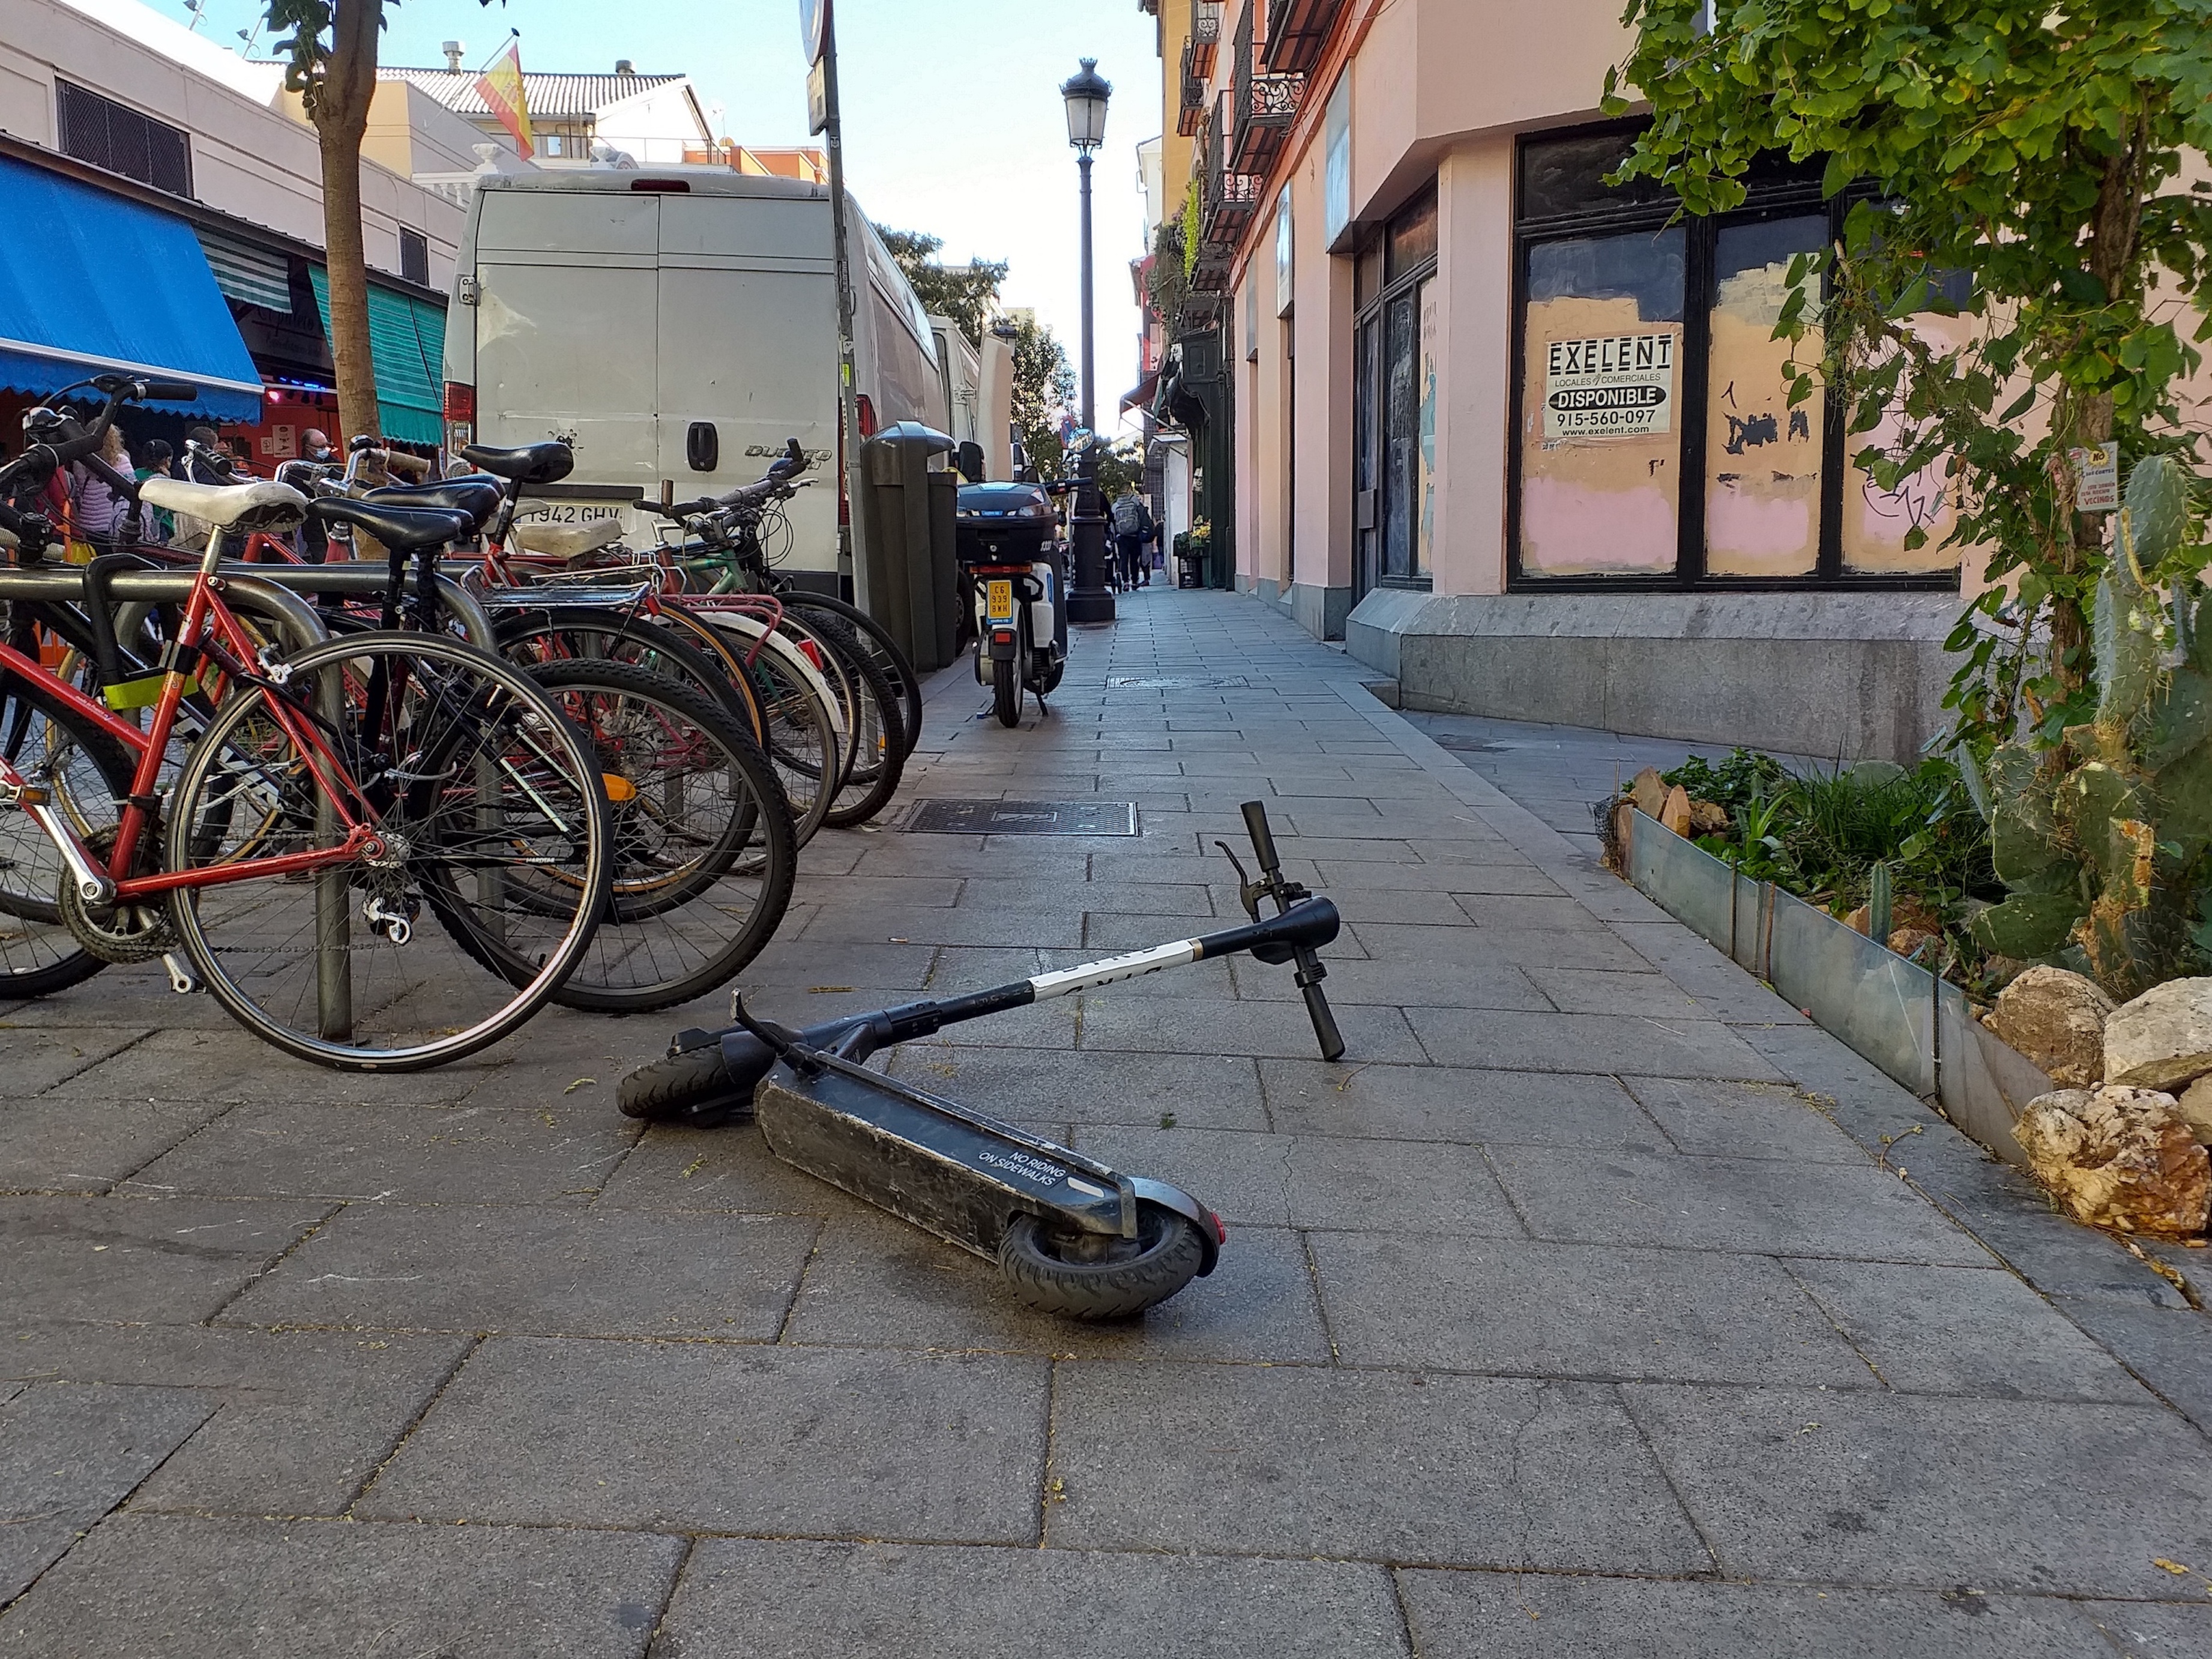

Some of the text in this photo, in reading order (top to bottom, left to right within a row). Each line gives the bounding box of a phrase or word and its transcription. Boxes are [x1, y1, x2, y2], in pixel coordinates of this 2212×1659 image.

[1550, 337, 1672, 373] EXELENT
[1555, 373, 1661, 387] LOCALES COMERCIALES
[1558, 387, 1657, 408] DISPONIBLE
[1557, 409, 1656, 426] 915-560-097
[1562, 426, 1650, 436] www.exelent.com
[2093, 453, 2105, 462] NO
[978, 1151, 1056, 1186] ON SIDEWALKS
[1009, 1151, 1067, 1177] NO RIDING
